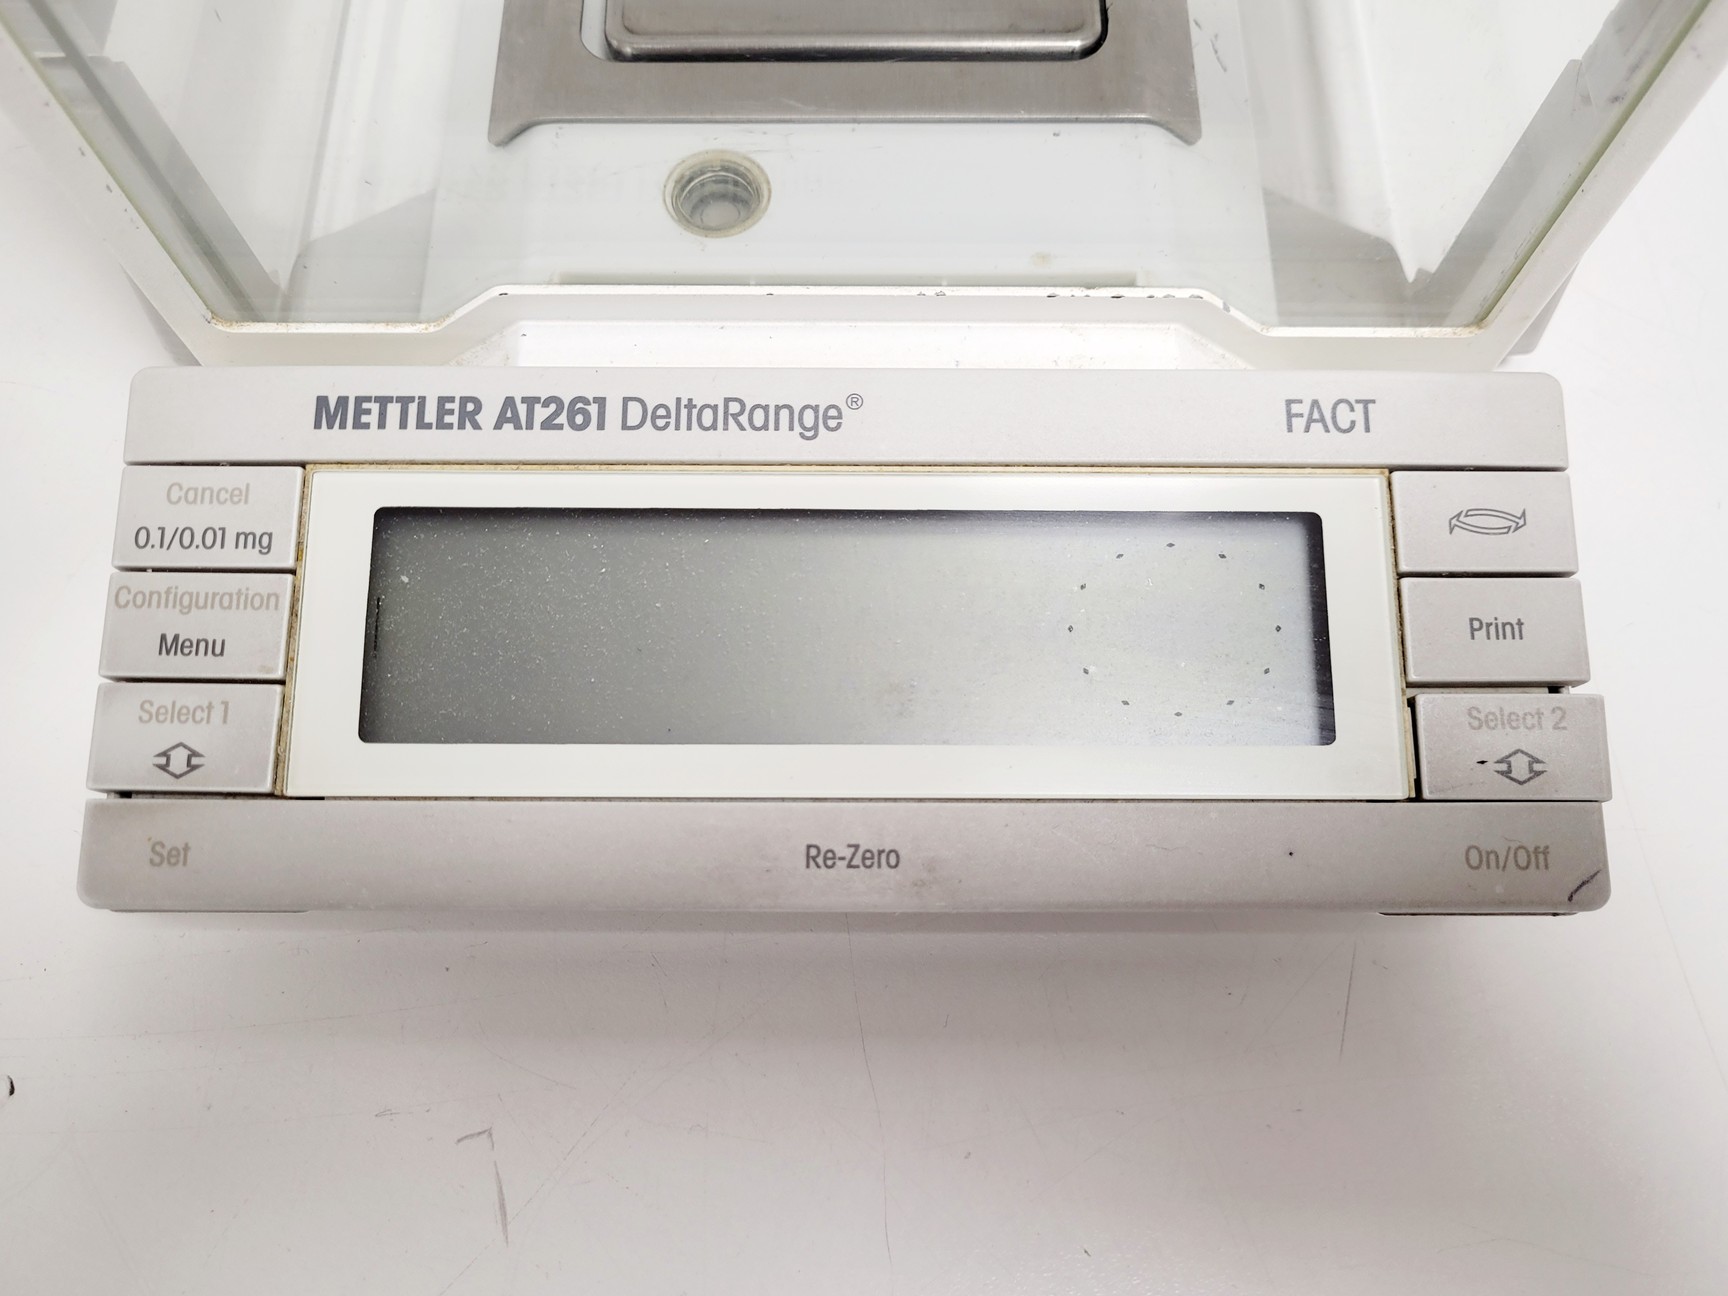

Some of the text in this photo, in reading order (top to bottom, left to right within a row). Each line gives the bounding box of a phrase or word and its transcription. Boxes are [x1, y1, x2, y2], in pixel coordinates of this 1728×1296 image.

[313, 396, 483, 431] METTLER
[493, 396, 607, 431] AT261
[1285, 399, 1377, 435] FACT
[167, 482, 250, 506] Cancel
[135, 527, 273, 555] 0.1/0.01 mg
[115, 585, 280, 615] Configuration
[1468, 617, 1525, 641] Print
[158, 633, 226, 658] Menu
[139, 700, 230, 725] Select 1
[1467, 706, 1568, 731] Select 2
[149, 840, 191, 868] Set
[806, 844, 901, 870] Re-Zero
[1465, 845, 1550, 873] On/Off
